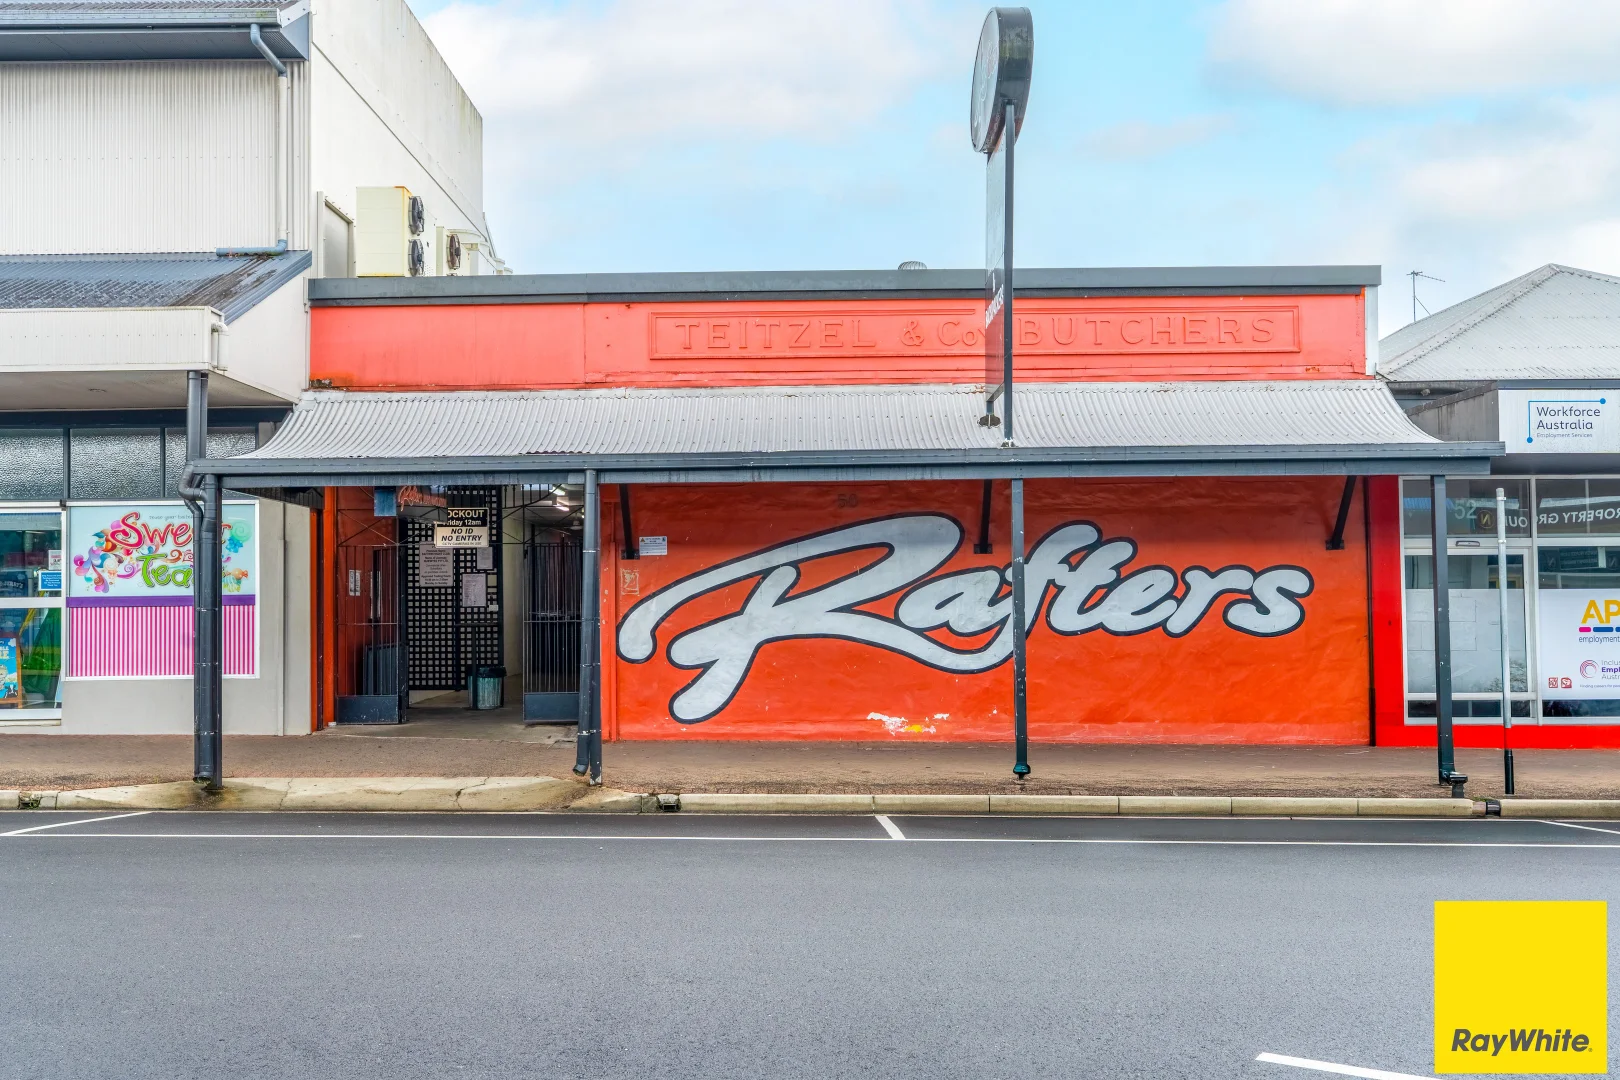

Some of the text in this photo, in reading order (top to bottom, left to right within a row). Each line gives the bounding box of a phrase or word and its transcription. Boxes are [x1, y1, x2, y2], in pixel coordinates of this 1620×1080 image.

[675, 319, 876, 349] TEITZEL
[900, 319, 925, 347] &
[1018, 315, 1275, 346] BUTCHERS
[1536, 405, 1601, 417] Workforce
[1536, 418, 1594, 430] Australia
[447, 510, 484, 518] OCKOUT
[1454, 500, 1477, 519] 52
[615, 511, 1314, 724] Rafters
